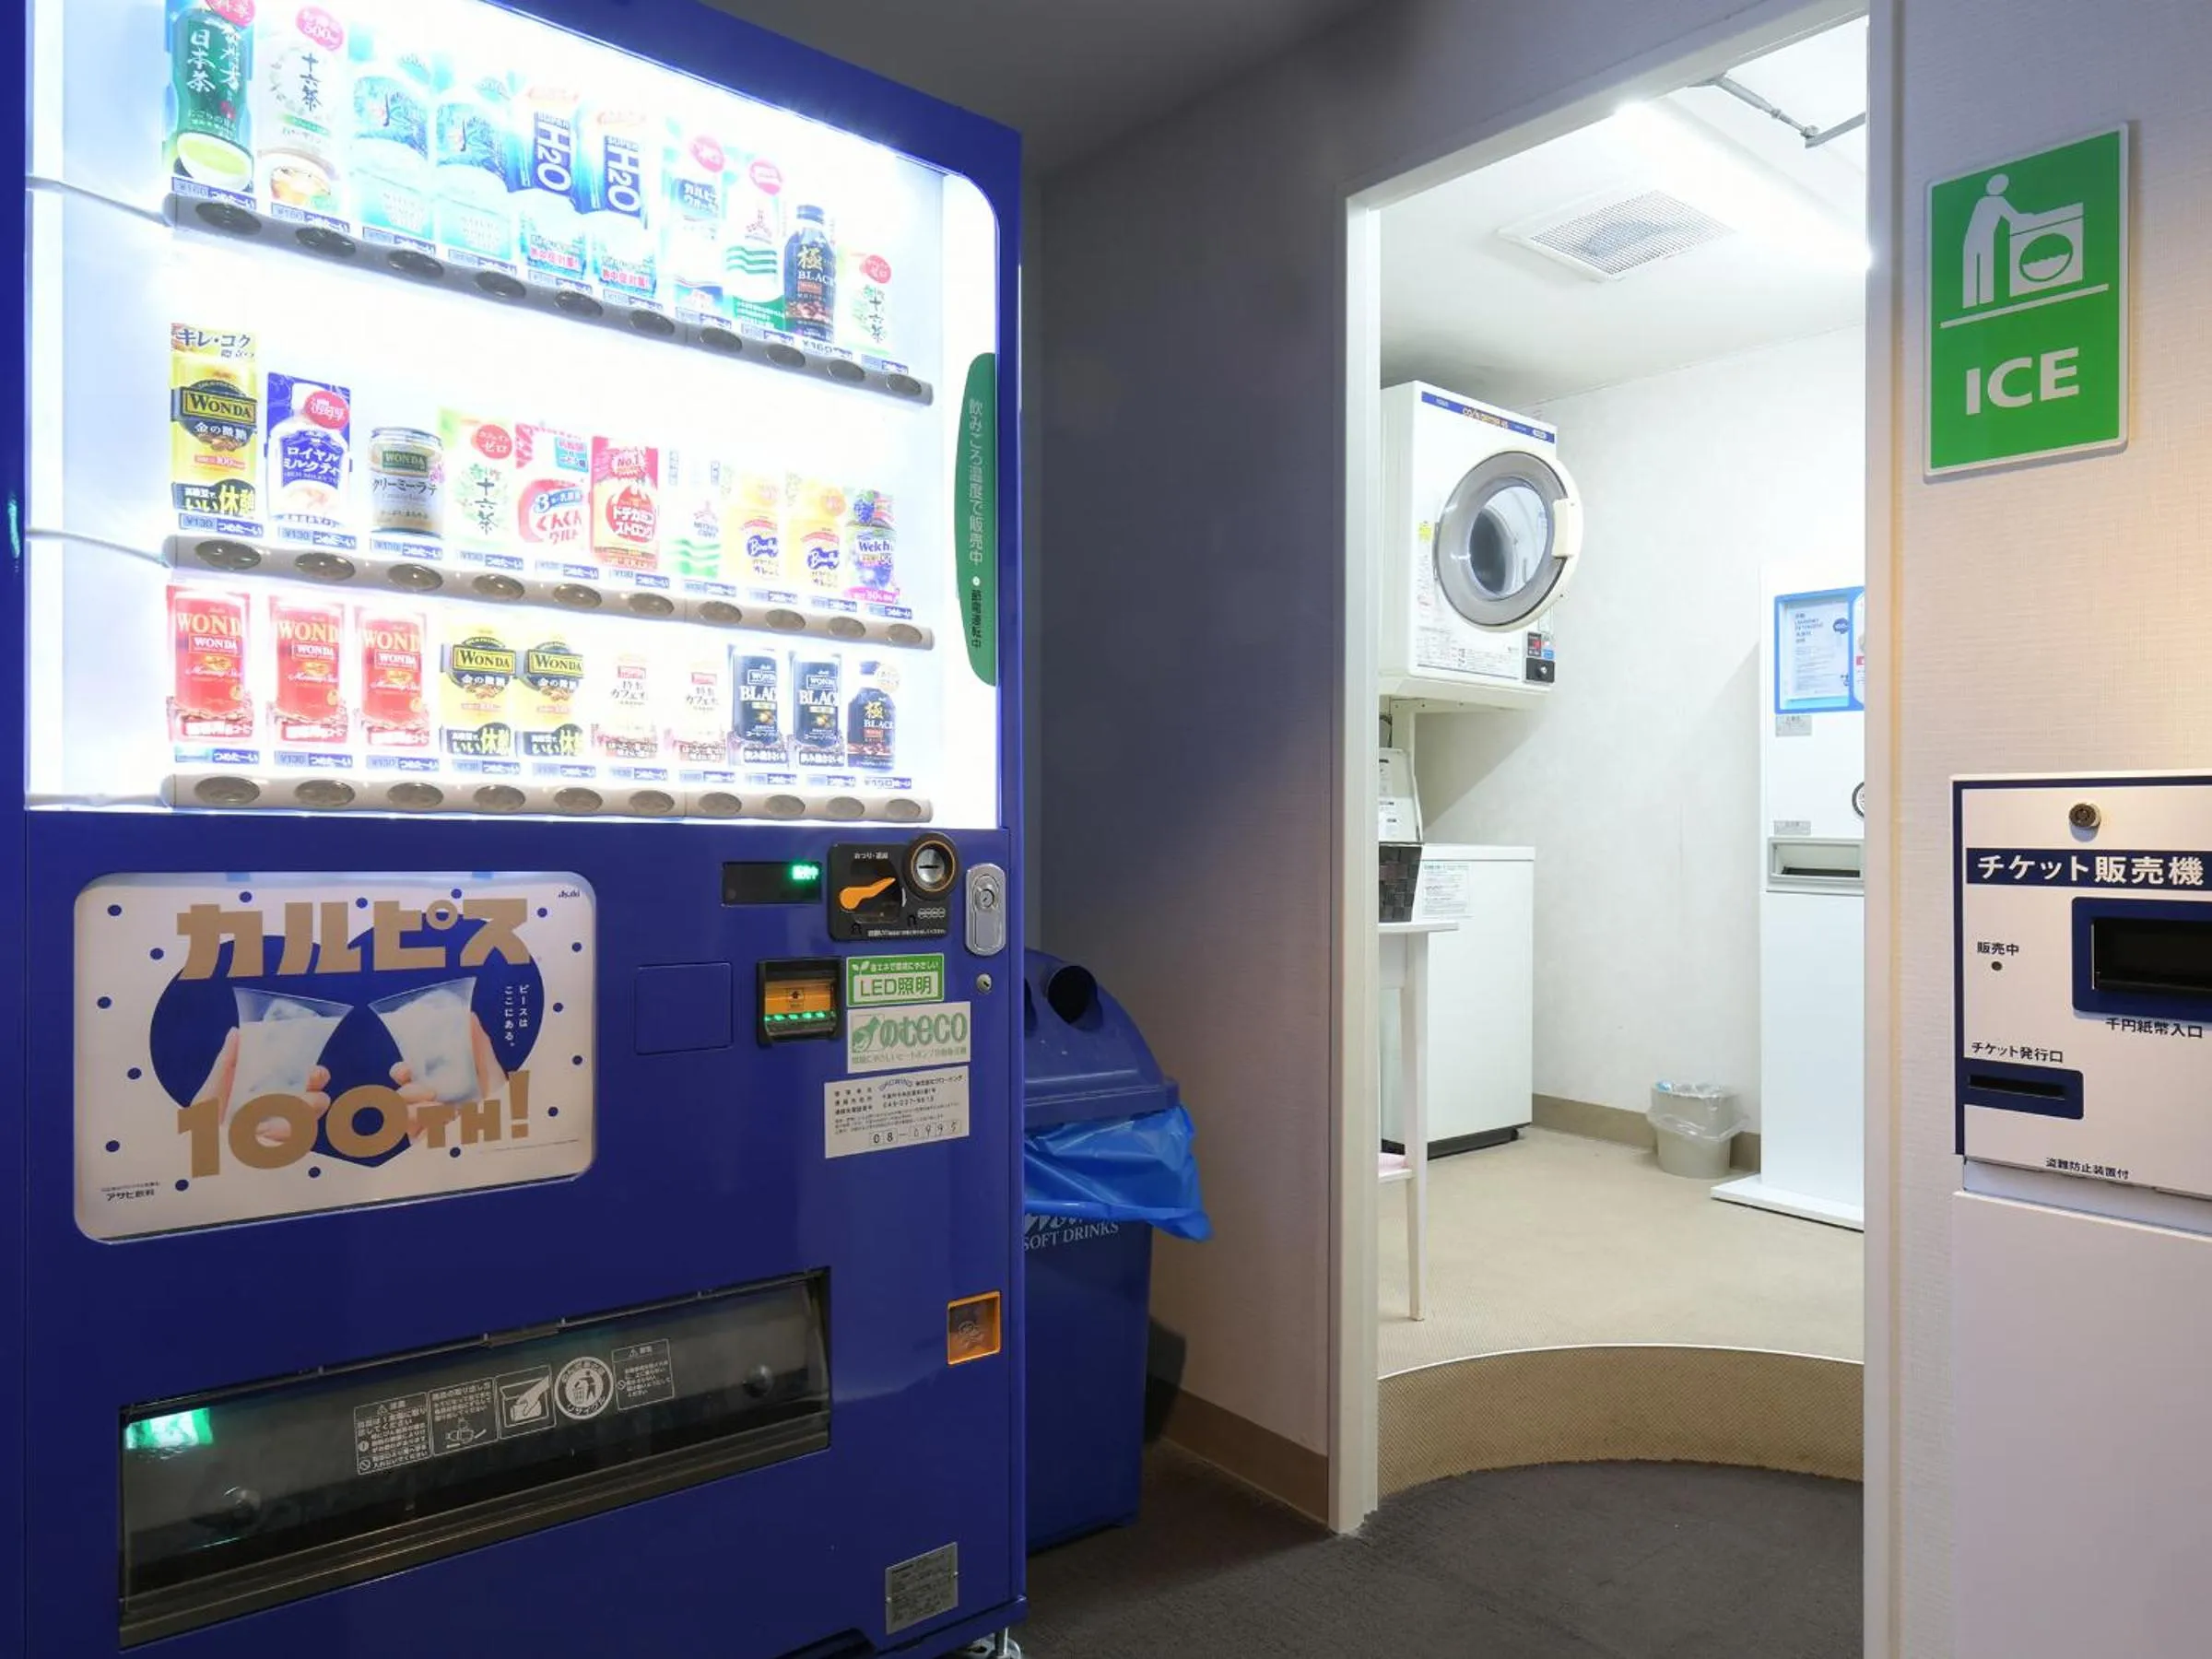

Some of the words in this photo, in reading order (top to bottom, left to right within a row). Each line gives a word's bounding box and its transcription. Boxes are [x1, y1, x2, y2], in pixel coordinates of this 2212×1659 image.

[187, 29, 215, 92] 日本茶
[300, 53, 323, 112] 十六茶
[537, 121, 571, 192] H2O
[606, 146, 641, 212] H2O
[868, 295, 887, 344] 十六茶
[1966, 347, 2079, 416] ICE
[189, 394, 253, 418] WONDA
[287, 447, 339, 464] ロイヤル
[383, 453, 425, 466] WONDA
[475, 477, 498, 535] 十六茶
[194, 638, 237, 651] WONDA
[297, 644, 334, 657] WONDA
[378, 653, 417, 665] WONDA
[460, 650, 511, 668] WONDA
[535, 654, 582, 672] WONDA
[1977, 855, 2204, 887] チケット販売機
[177, 899, 529, 980] カルピス
[1976, 941, 2019, 956] 販売中
[860, 975, 932, 996] LED照明
[502, 984, 515, 1048] ここにある。
[518, 982, 528, 1029] ピースは
[2106, 1017, 2203, 1039] 千円紙幣入口
[1971, 1041, 2064, 1064] チケット発行口
[2045, 1157, 2130, 1180] 盗難防止装置付
[1063, 1221, 1119, 1243] DRINKS
